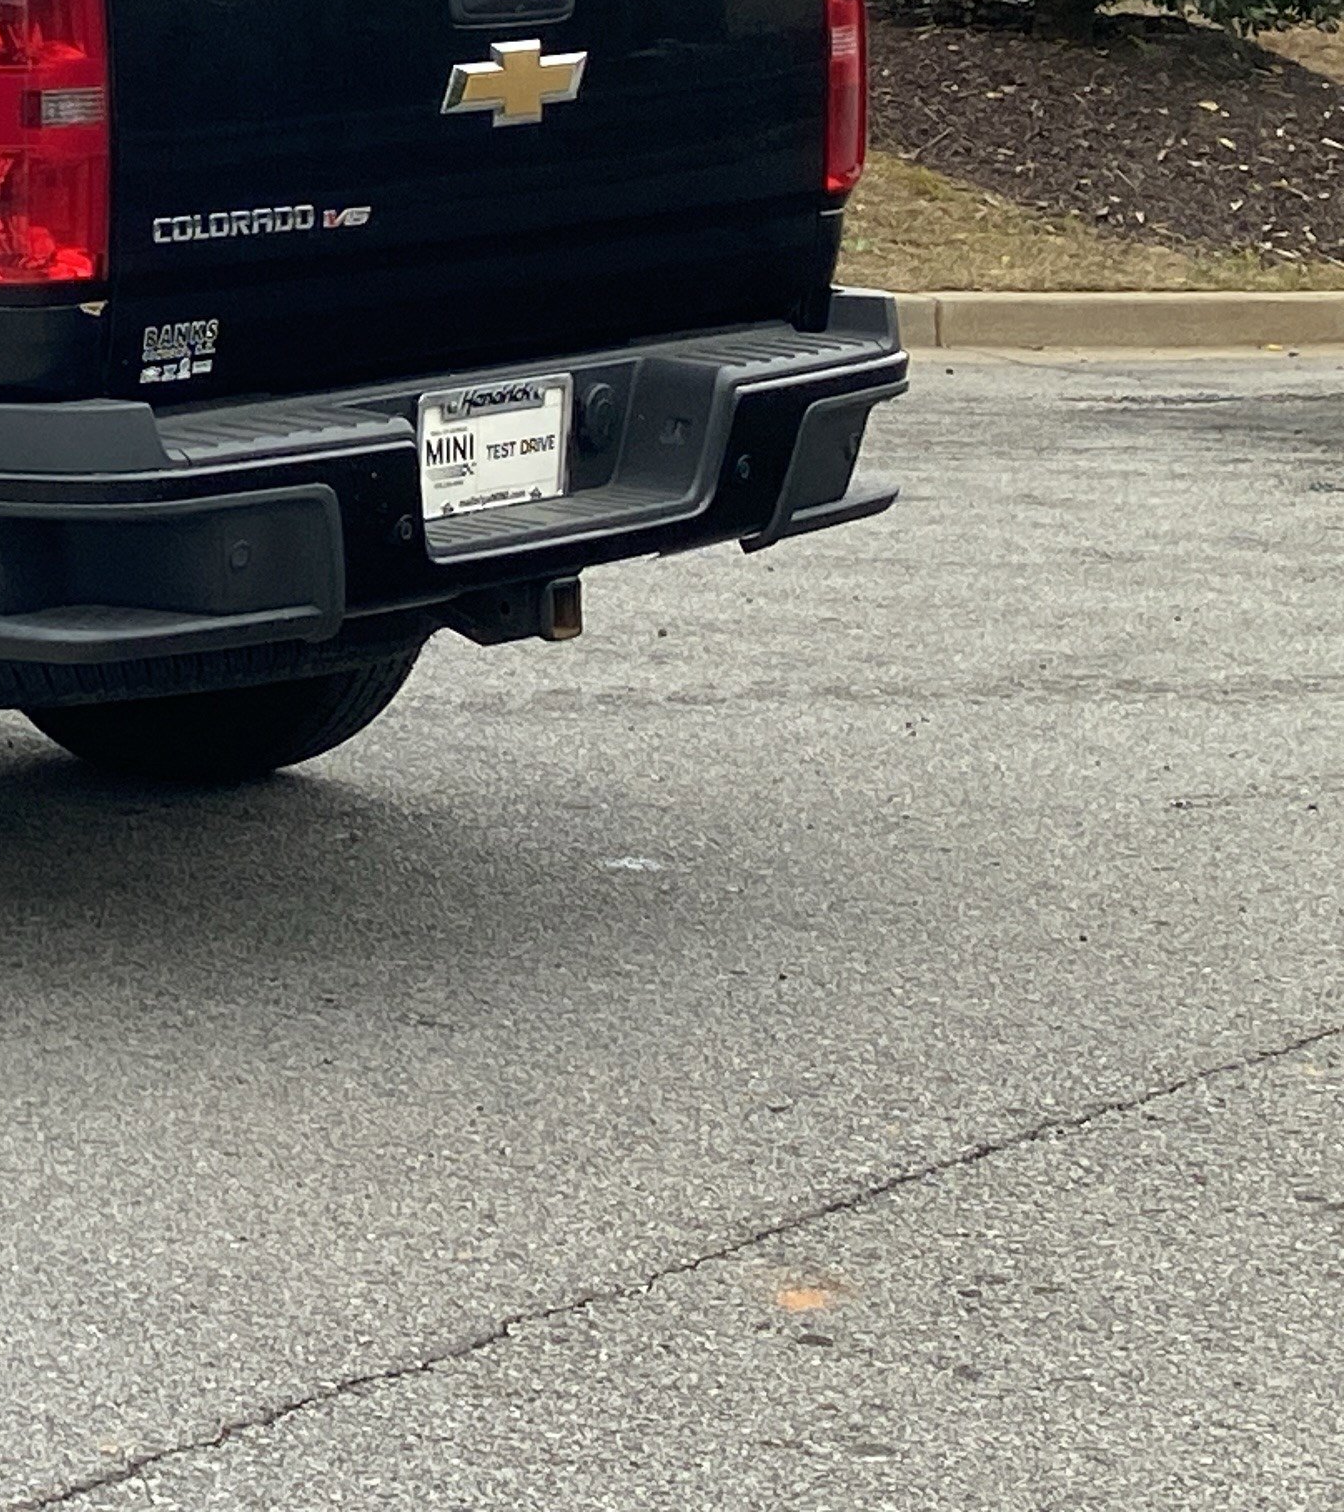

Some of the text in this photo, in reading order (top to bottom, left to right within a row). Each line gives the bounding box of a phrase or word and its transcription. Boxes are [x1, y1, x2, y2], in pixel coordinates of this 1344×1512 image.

[153, 204, 372, 244] COLORADO V6
[143, 318, 220, 351] BANKS
[426, 432, 475, 467] MINI
[485, 433, 556, 462] TEST DRIVE
